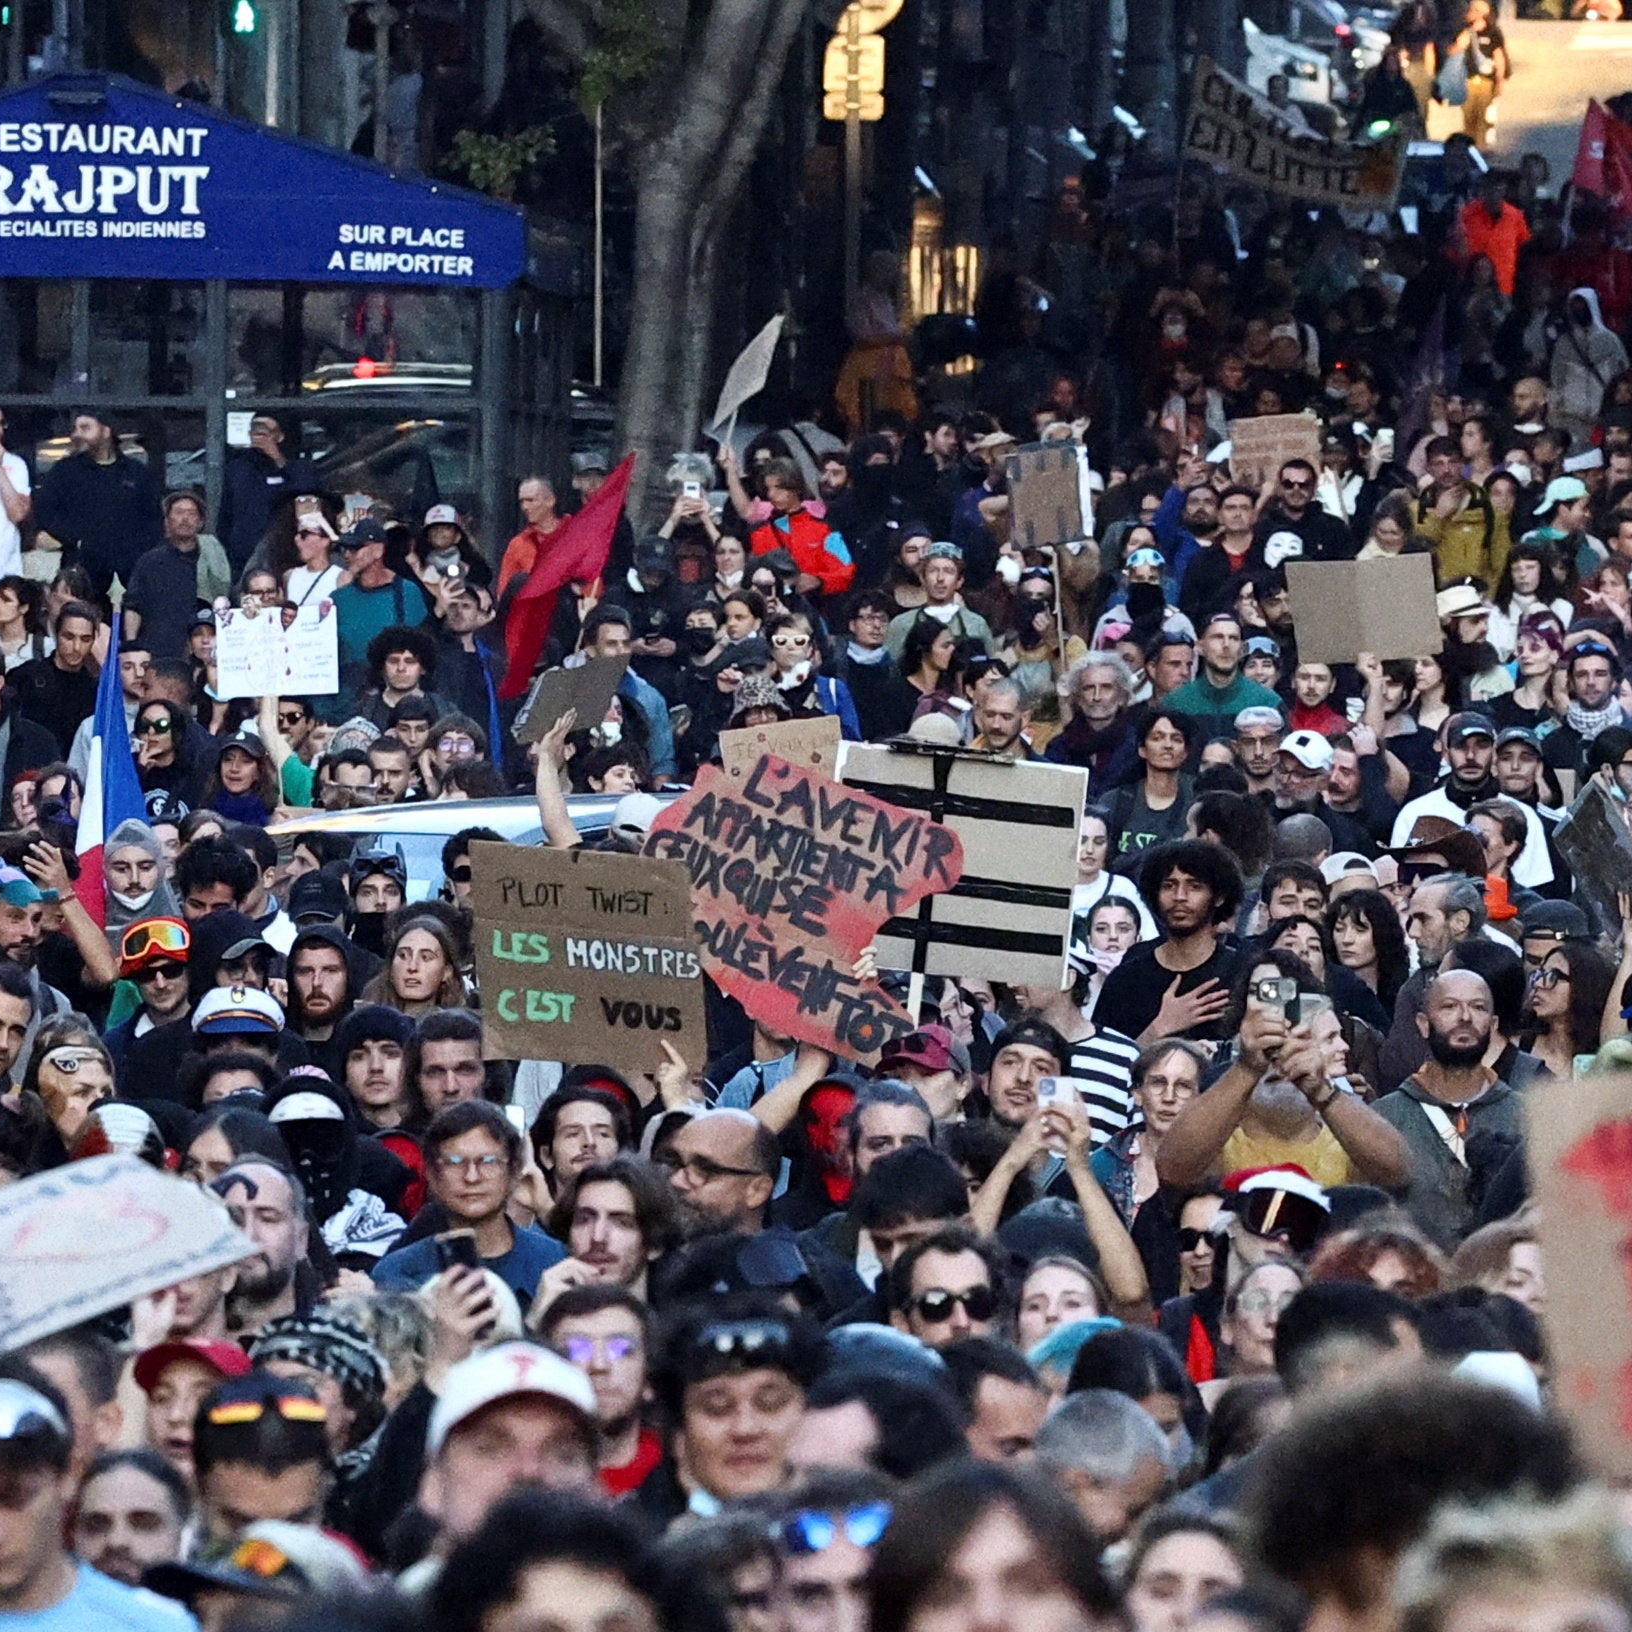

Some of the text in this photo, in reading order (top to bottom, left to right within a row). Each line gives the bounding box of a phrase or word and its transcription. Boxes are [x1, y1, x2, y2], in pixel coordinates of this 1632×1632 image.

[102, 220, 206, 239] INDIENNES
[338, 223, 465, 249] SUR PLACE
[327, 250, 474, 277] A EMPORTER
[743, 753, 955, 891] L'AVENIR
[682, 791, 876, 893] APPARTIENT
[496, 876, 565, 909] PLOT
[585, 885, 655, 917] TWIST
[491, 928, 702, 980] LES MONSTRES
[599, 996, 683, 1032] VOUS
